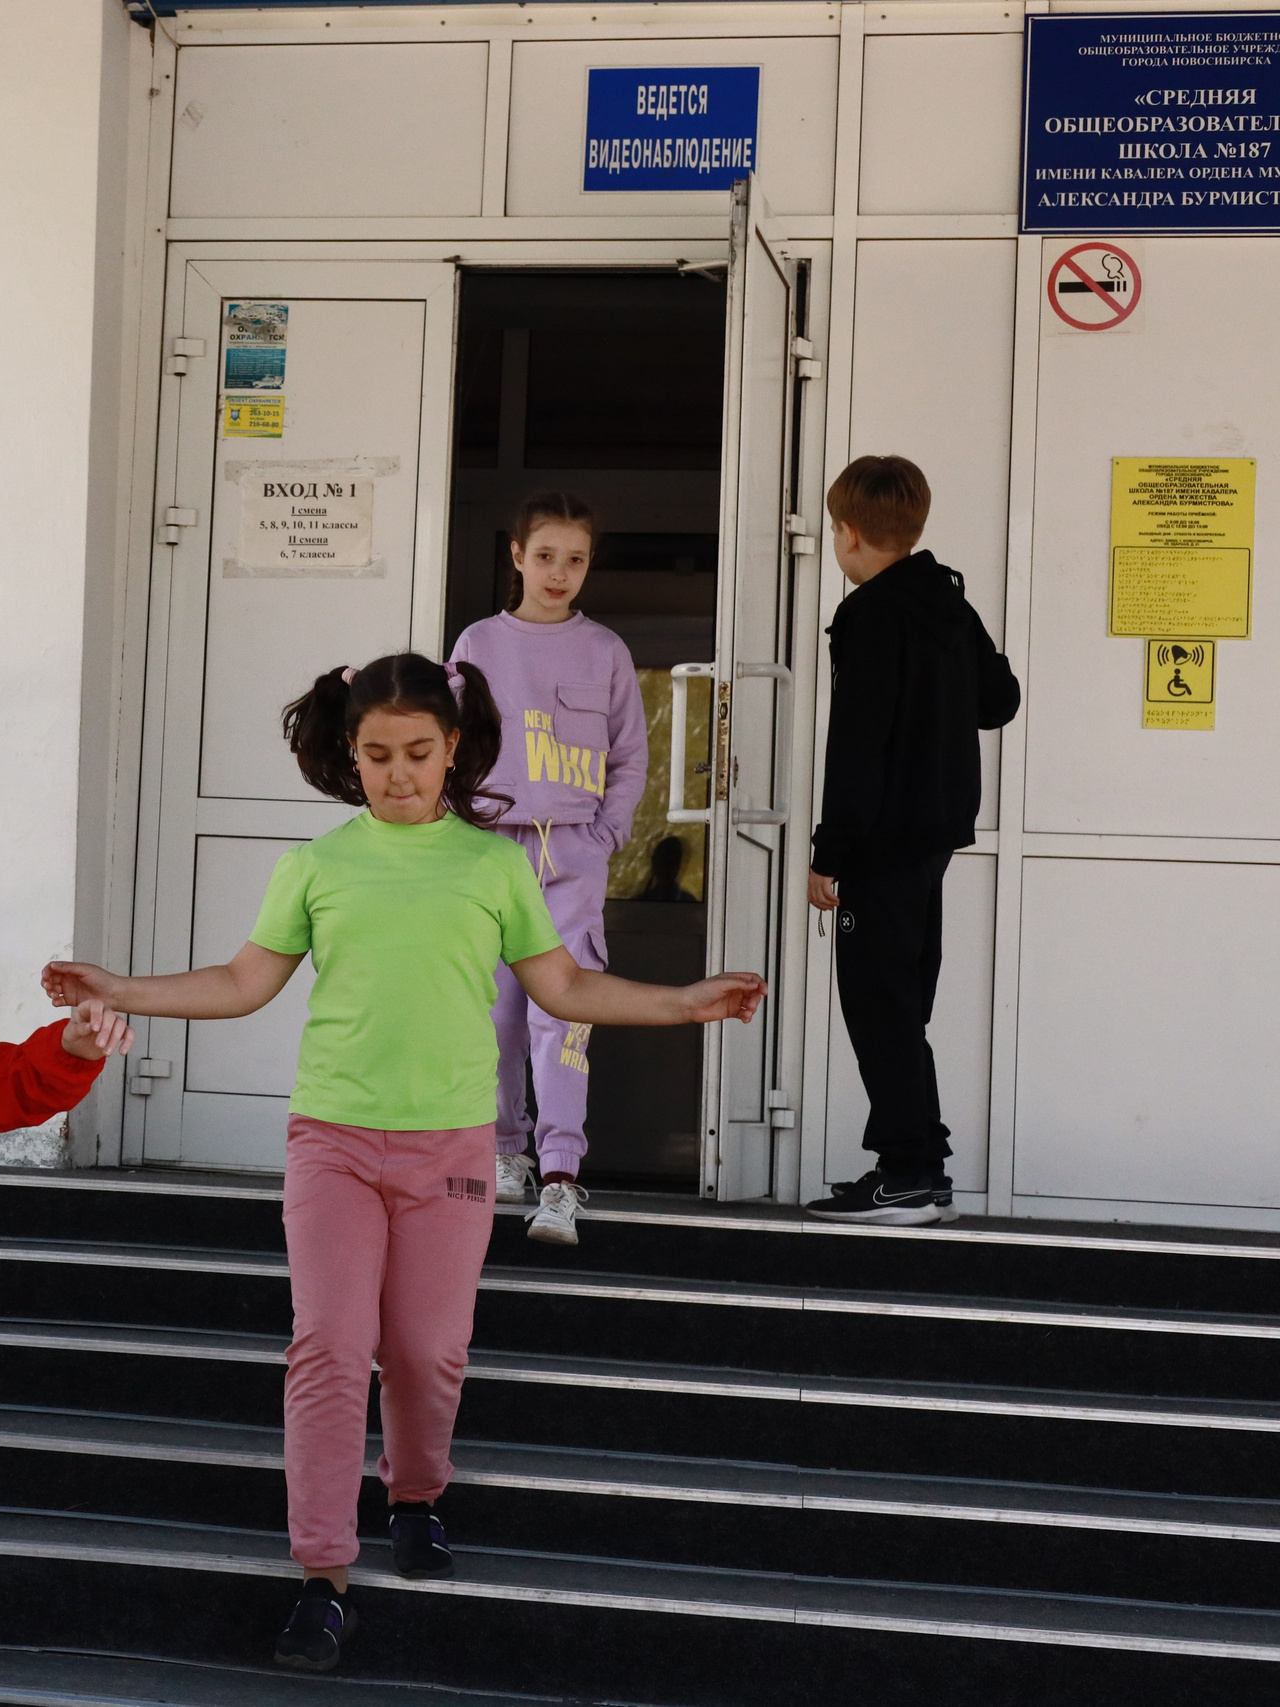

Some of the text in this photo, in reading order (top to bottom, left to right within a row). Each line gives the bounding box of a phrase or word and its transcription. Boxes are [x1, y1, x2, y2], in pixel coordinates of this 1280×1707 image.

[1100, 32, 1280, 44] МУНИЦИПАЛЬНОЕ БЮДЖЕТН
[1078, 45, 1229, 56] ОБЩЕОБРАЗОВАТЕЛЬНОЕ
[1122, 56, 1271, 67] ГОРОДА НОВОСИБИРСКА
[637, 84, 709, 121] ВЕДЕТСЯ
[1134, 89, 1257, 108] «СРЕДНЯЯ
[1044, 116, 1280, 136] ОБЩЕОБРАЗОВАТЕЛ
[588, 137, 753, 175] ВИДЕОНАБЛЮДЕНИЕ
[1119, 142, 1272, 159] ШКОЛА №187
[1035, 169, 1096, 180] ИМЕНИ
[1101, 168, 1184, 180] КАВАЛЕРА
[1189, 167, 1254, 181] ОРДЕНА
[1038, 192, 1176, 209] АЛЕКСАНДРА
[263, 483, 356, 500] ВХОД № 1
[259, 521, 358, 531] 5, 8, 9, 10, 11 классы
[299, 537, 328, 545] смена
[280, 550, 289, 559] 6,
[291, 550, 297, 559] 7
[447, 1191, 464, 1200] NICE
